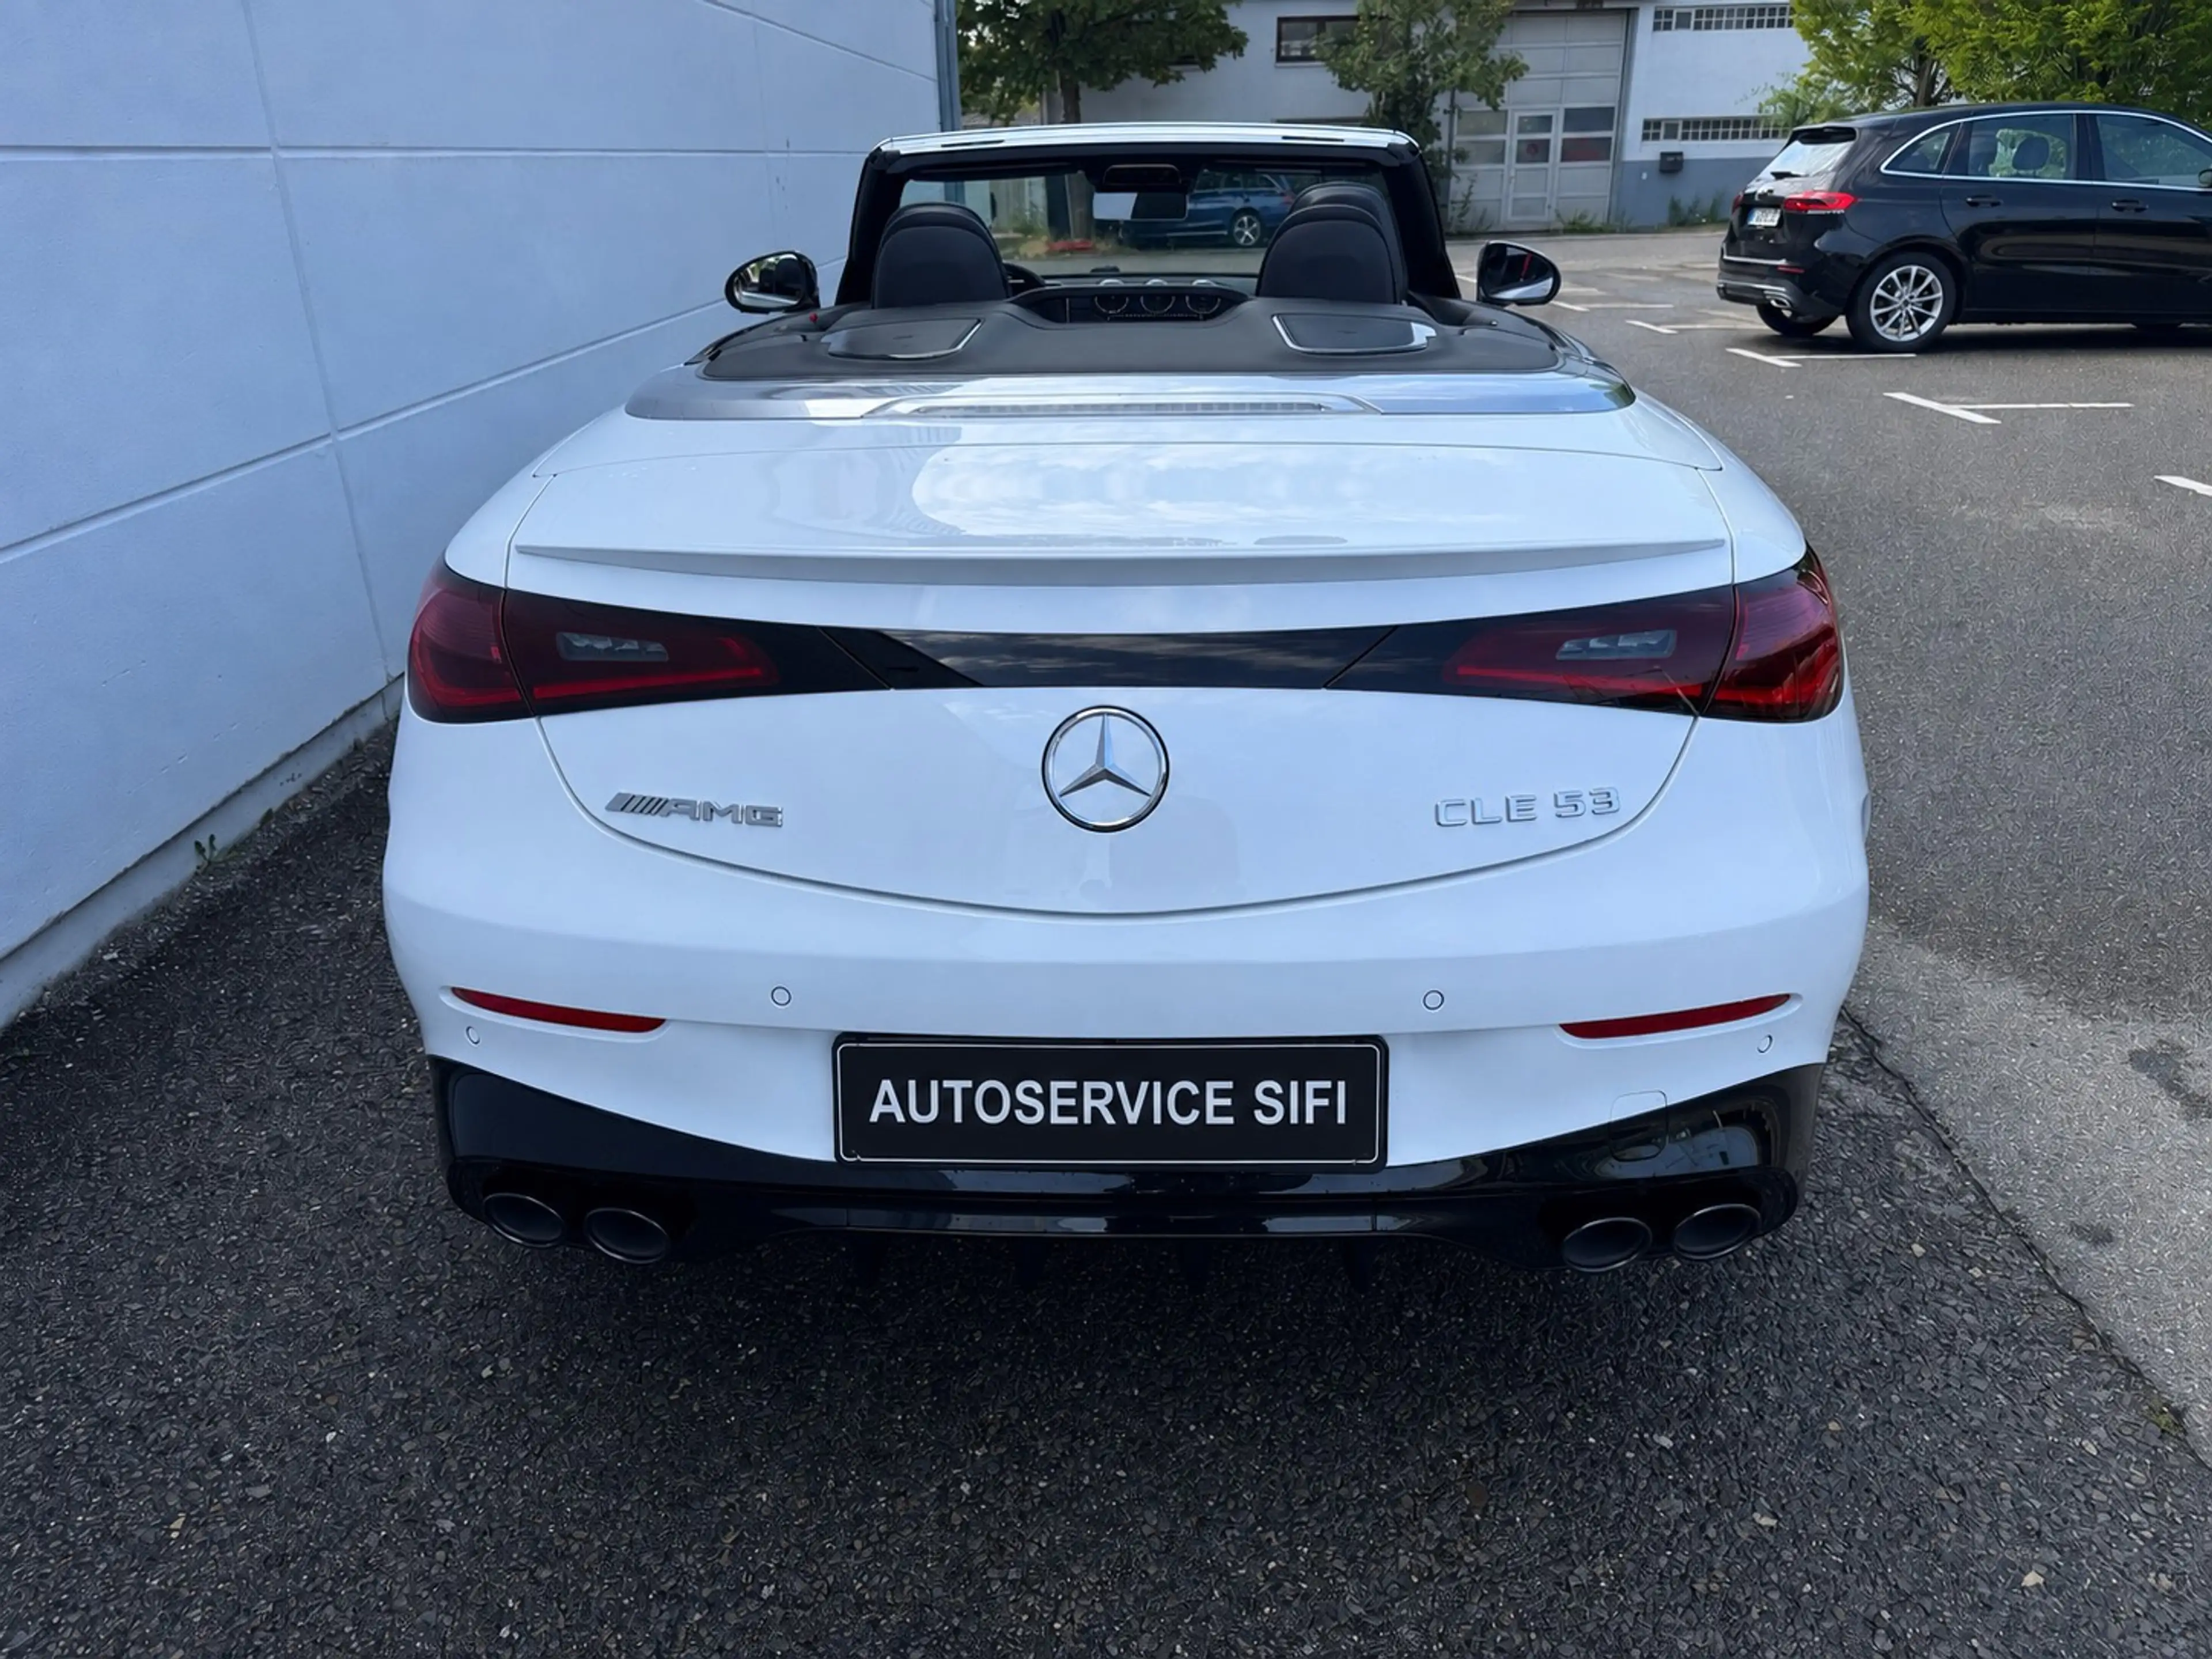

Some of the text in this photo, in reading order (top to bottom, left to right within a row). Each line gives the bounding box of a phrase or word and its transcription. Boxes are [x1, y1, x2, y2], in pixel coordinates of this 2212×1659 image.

[659, 797, 783, 828] AMG
[1435, 786, 1621, 827] CLE 53
[869, 1079, 1346, 1125] AUTOSERVICE SIFI
